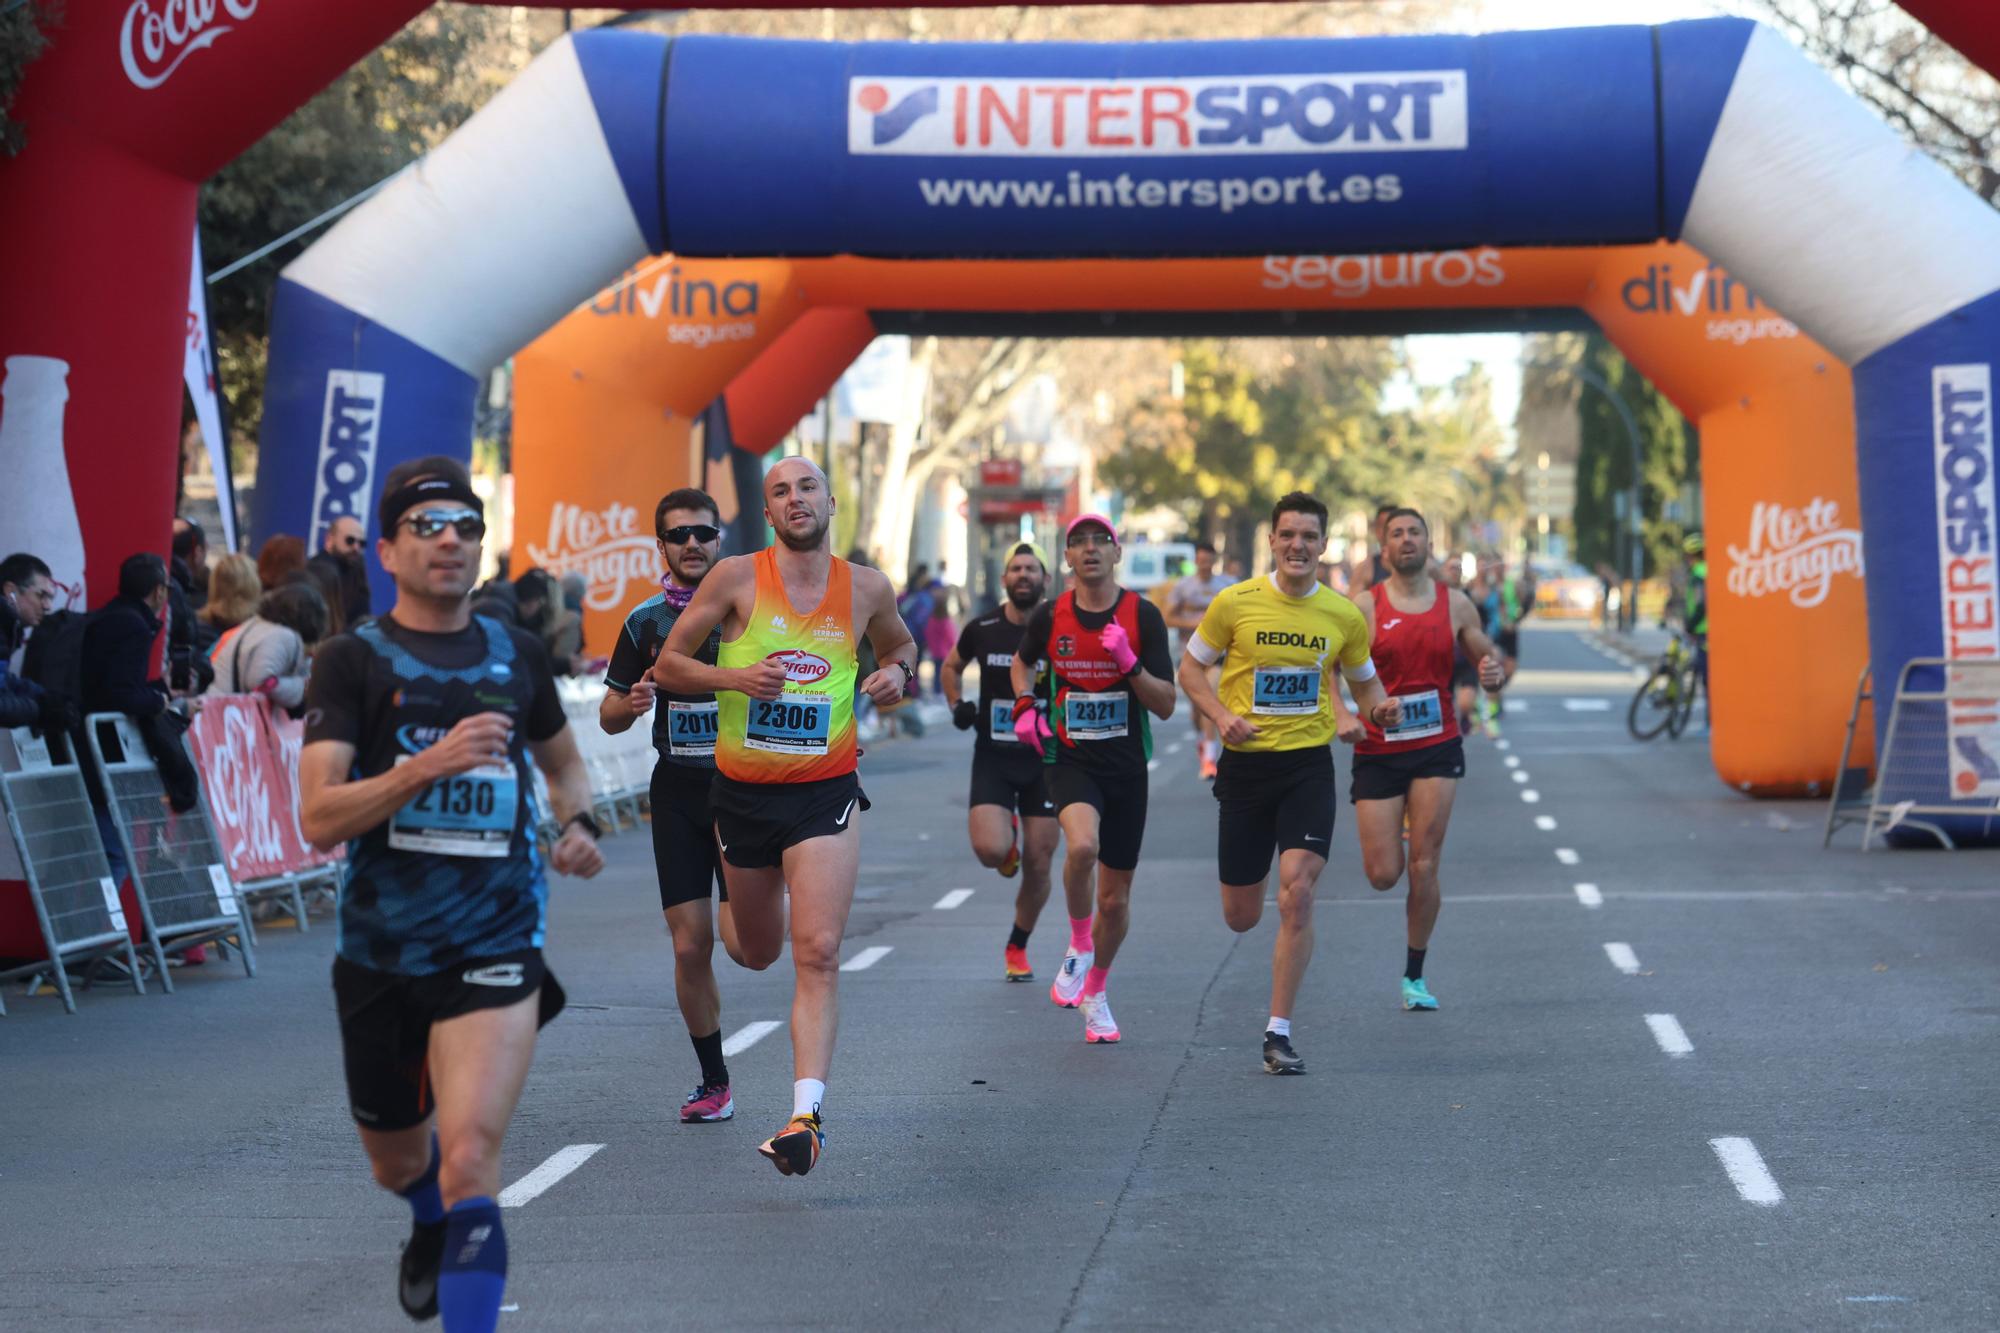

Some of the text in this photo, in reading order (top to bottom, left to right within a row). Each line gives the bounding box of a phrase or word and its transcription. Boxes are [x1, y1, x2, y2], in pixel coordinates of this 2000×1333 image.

[953, 80, 1445, 148] INTERSPORT
[920, 170, 1403, 211] www.intersport.es
[1262, 250, 1505, 298] seguros
[1621, 263, 1757, 316] divin
[667, 321, 756, 348] seguros
[1706, 318, 1799, 346] seguros
[317, 386, 376, 532] PORT
[813, 629, 845, 638] SERRANO
[778, 658, 826, 676] errano
[1263, 674, 1309, 695] 2234
[757, 702, 818, 730] 2306
[1076, 702, 1115, 720] 2321
[1403, 702, 1428, 720] 114
[413, 779, 495, 817] 2130
